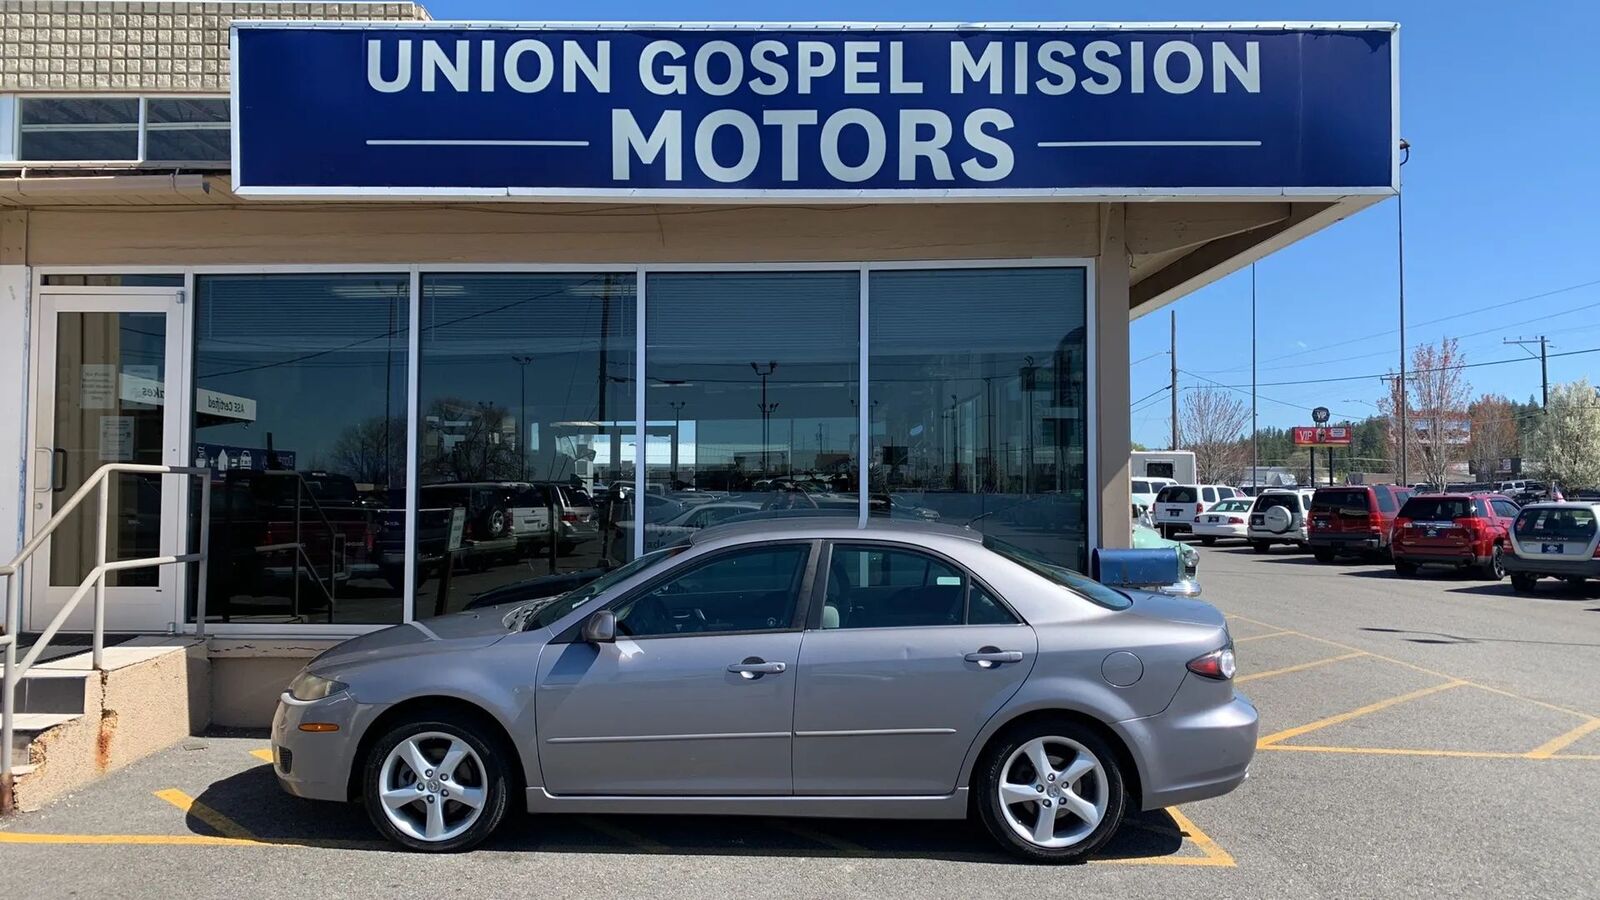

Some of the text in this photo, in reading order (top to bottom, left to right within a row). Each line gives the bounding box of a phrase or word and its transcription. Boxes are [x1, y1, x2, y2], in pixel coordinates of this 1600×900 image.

[367, 39, 1261, 96] UNION GOSPEL MISSION
[611, 108, 1016, 183] MOTORS
[1316, 411, 1327, 420] VIP
[1299, 430, 1313, 441] VIP
